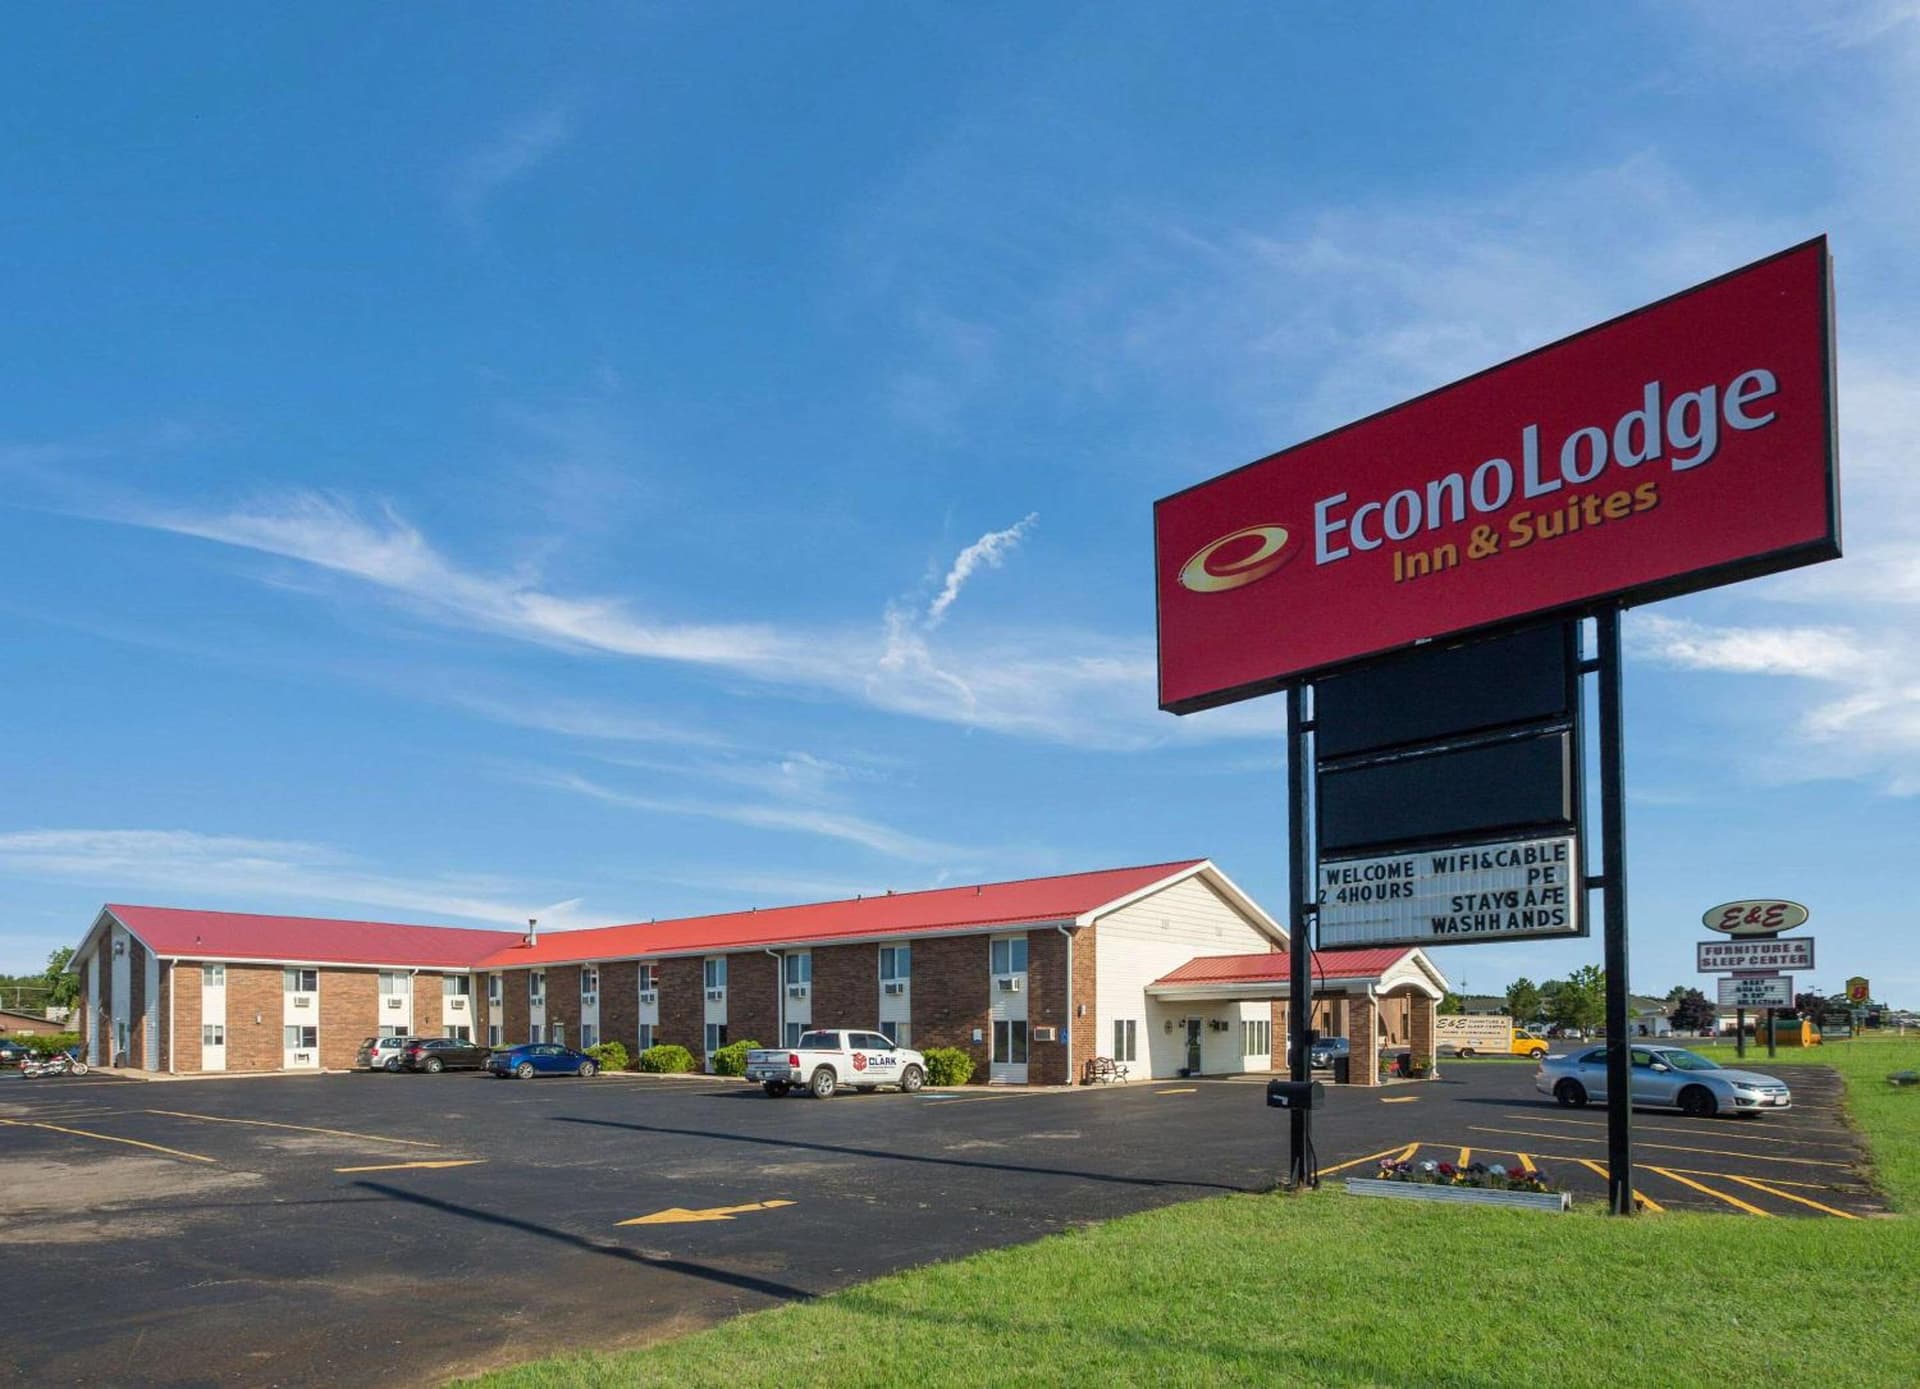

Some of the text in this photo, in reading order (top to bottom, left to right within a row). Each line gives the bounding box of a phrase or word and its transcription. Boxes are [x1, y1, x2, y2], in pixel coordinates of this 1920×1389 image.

[1314, 368, 1778, 566] EconoLodge
[1393, 481, 1659, 583] Inn & Suites
[1326, 844, 1566, 886] WELCOME WIFI&CABLE
[1527, 866, 1555, 885] PE
[1718, 903, 1789, 930] E&E
[1704, 943, 1806, 956] FURNITURE &
[1702, 954, 1809, 968] SLEEP CENTER
[1436, 1018, 1468, 1029] E&E
[868, 1057, 897, 1066] CLARK
